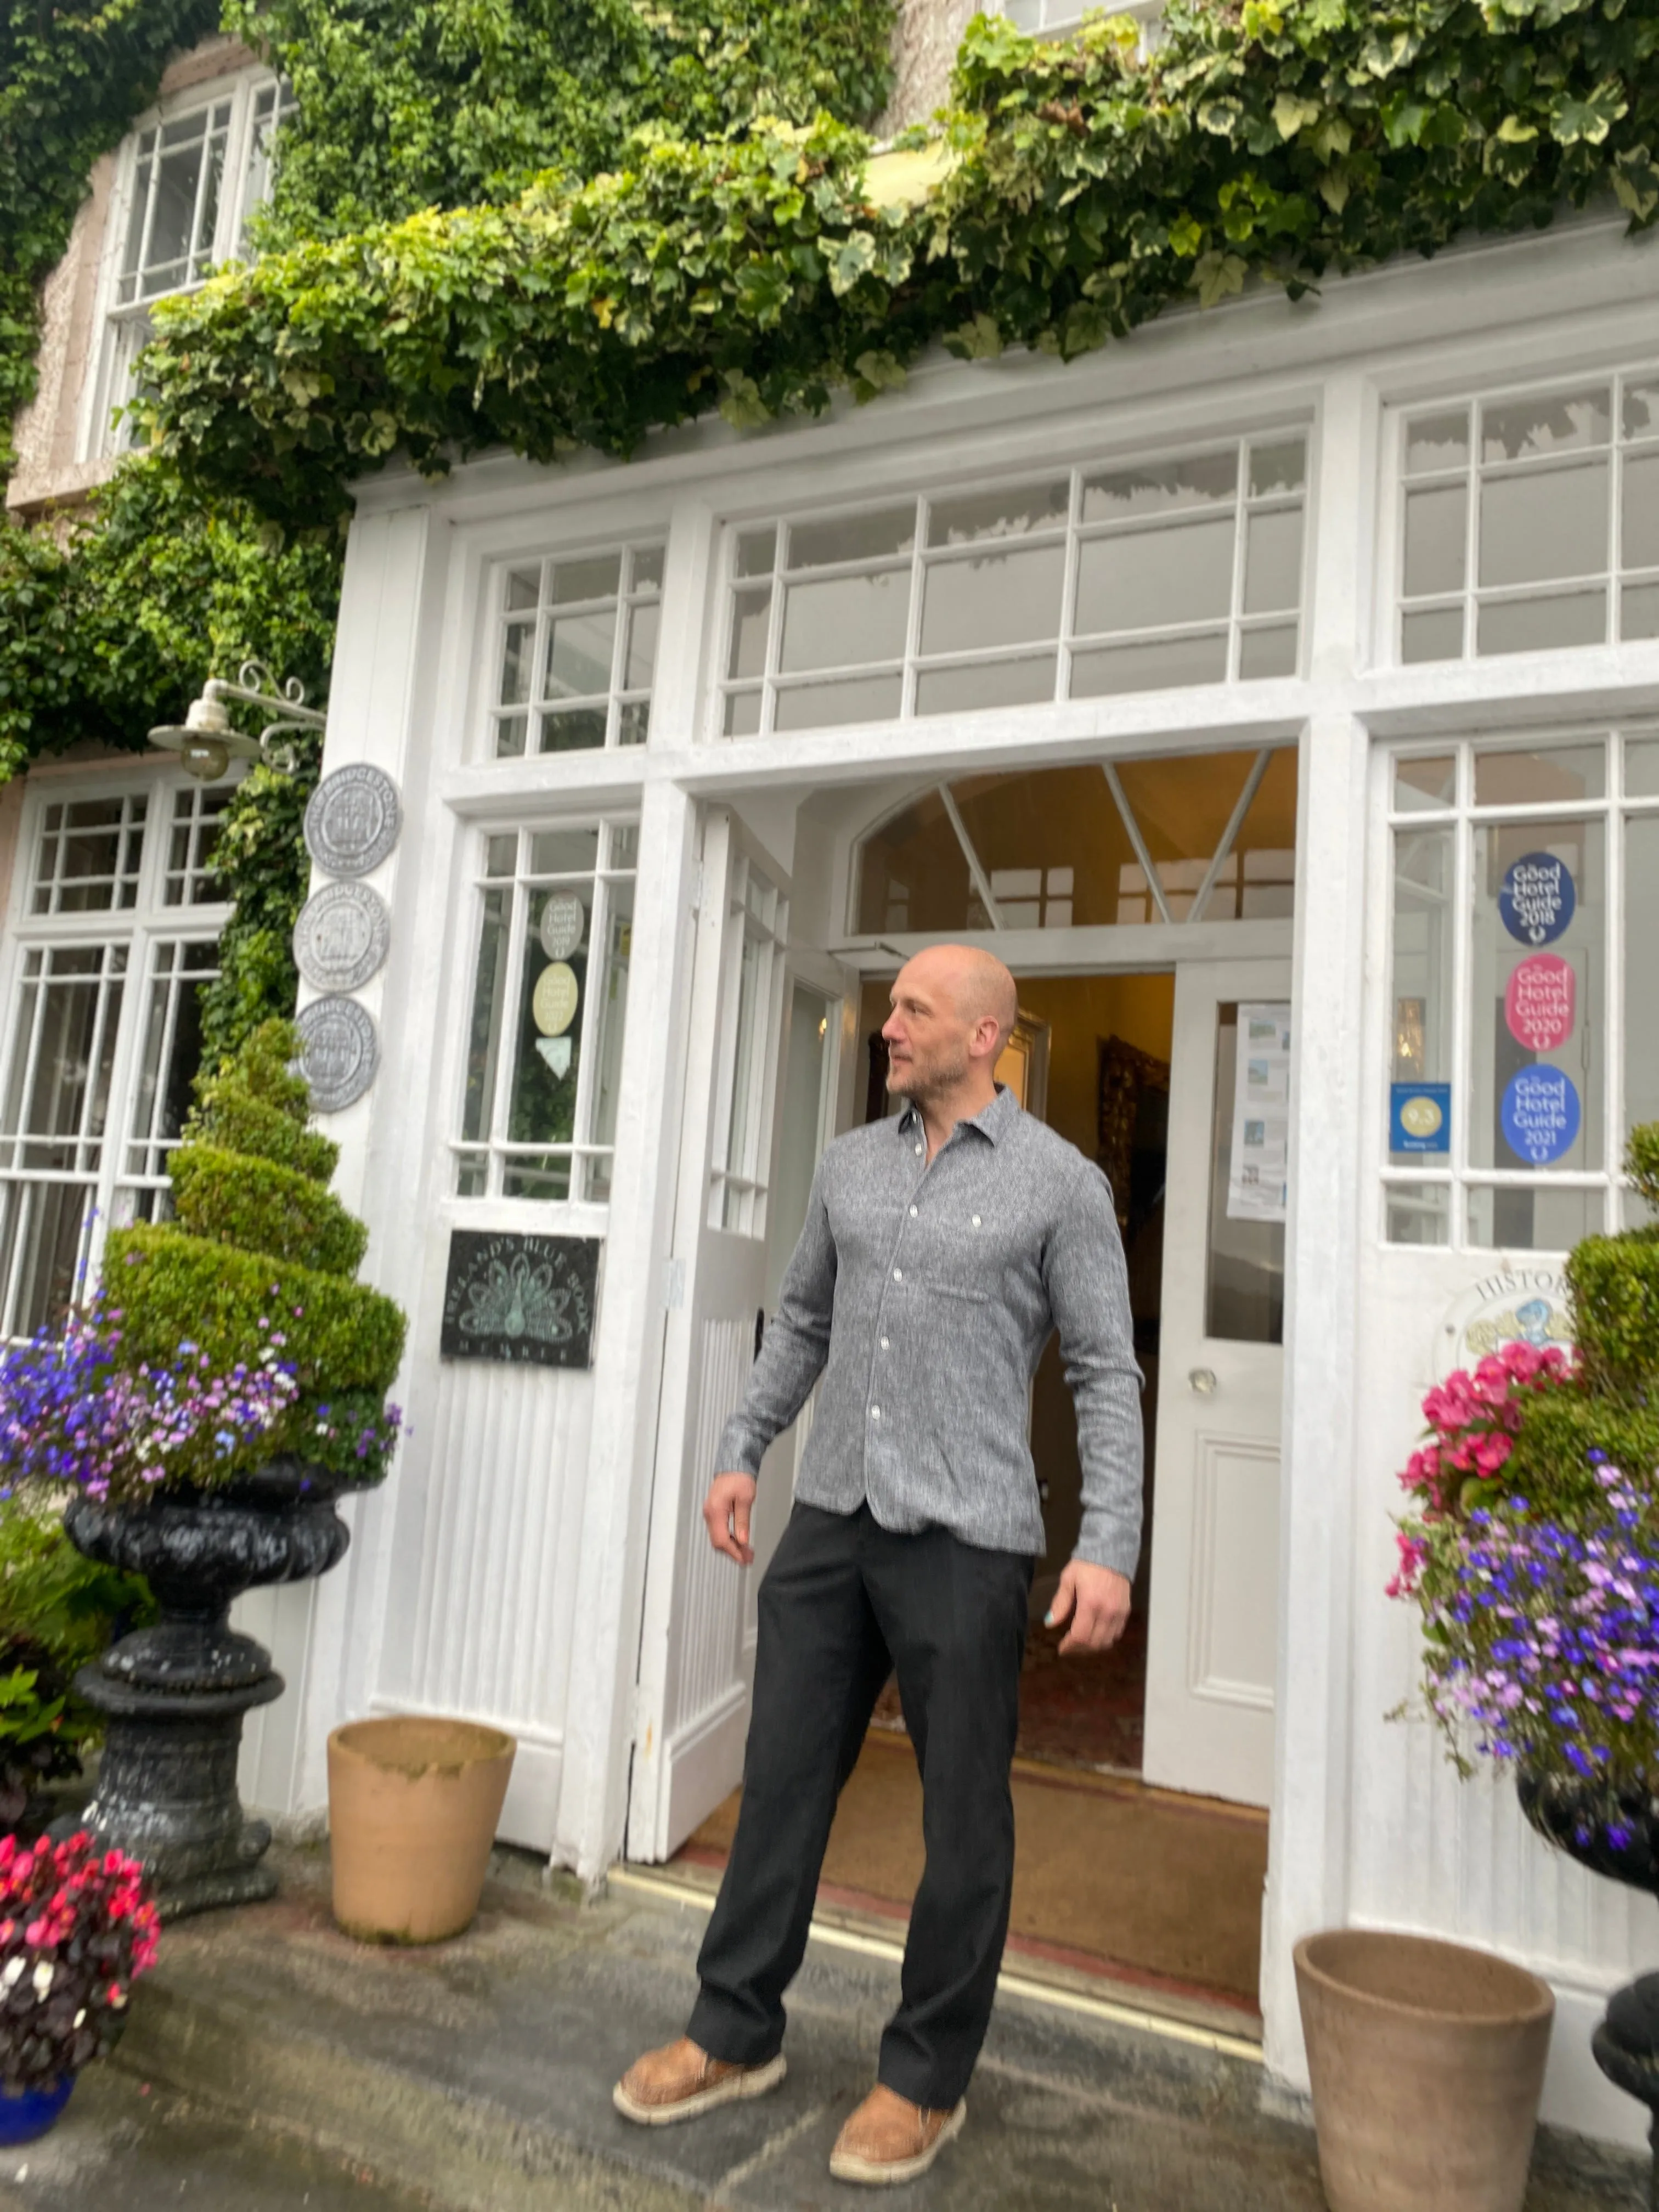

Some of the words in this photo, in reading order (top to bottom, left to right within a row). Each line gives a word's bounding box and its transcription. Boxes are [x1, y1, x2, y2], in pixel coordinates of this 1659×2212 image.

[1513, 862, 1561, 883] Good
[1513, 879, 1560, 897] Hotel
[549, 898, 577, 912] Good
[1512, 894, 1562, 911] Guide
[549, 911, 577, 924] Hotel
[547, 922, 576, 935] Guide
[1517, 966, 1568, 985] Good
[542, 985, 570, 998] Hotel
[1518, 984, 1568, 1001] Hotel
[540, 996, 569, 1009] Guide
[1515, 1000, 1571, 1018] Guide
[1523, 1018, 1563, 1035] 2020
[1515, 1077, 1566, 1097] Good
[1515, 1094, 1566, 1113] Hotel
[1513, 1110, 1567, 1130] Guide
[1524, 1128, 1556, 1147] 2021
